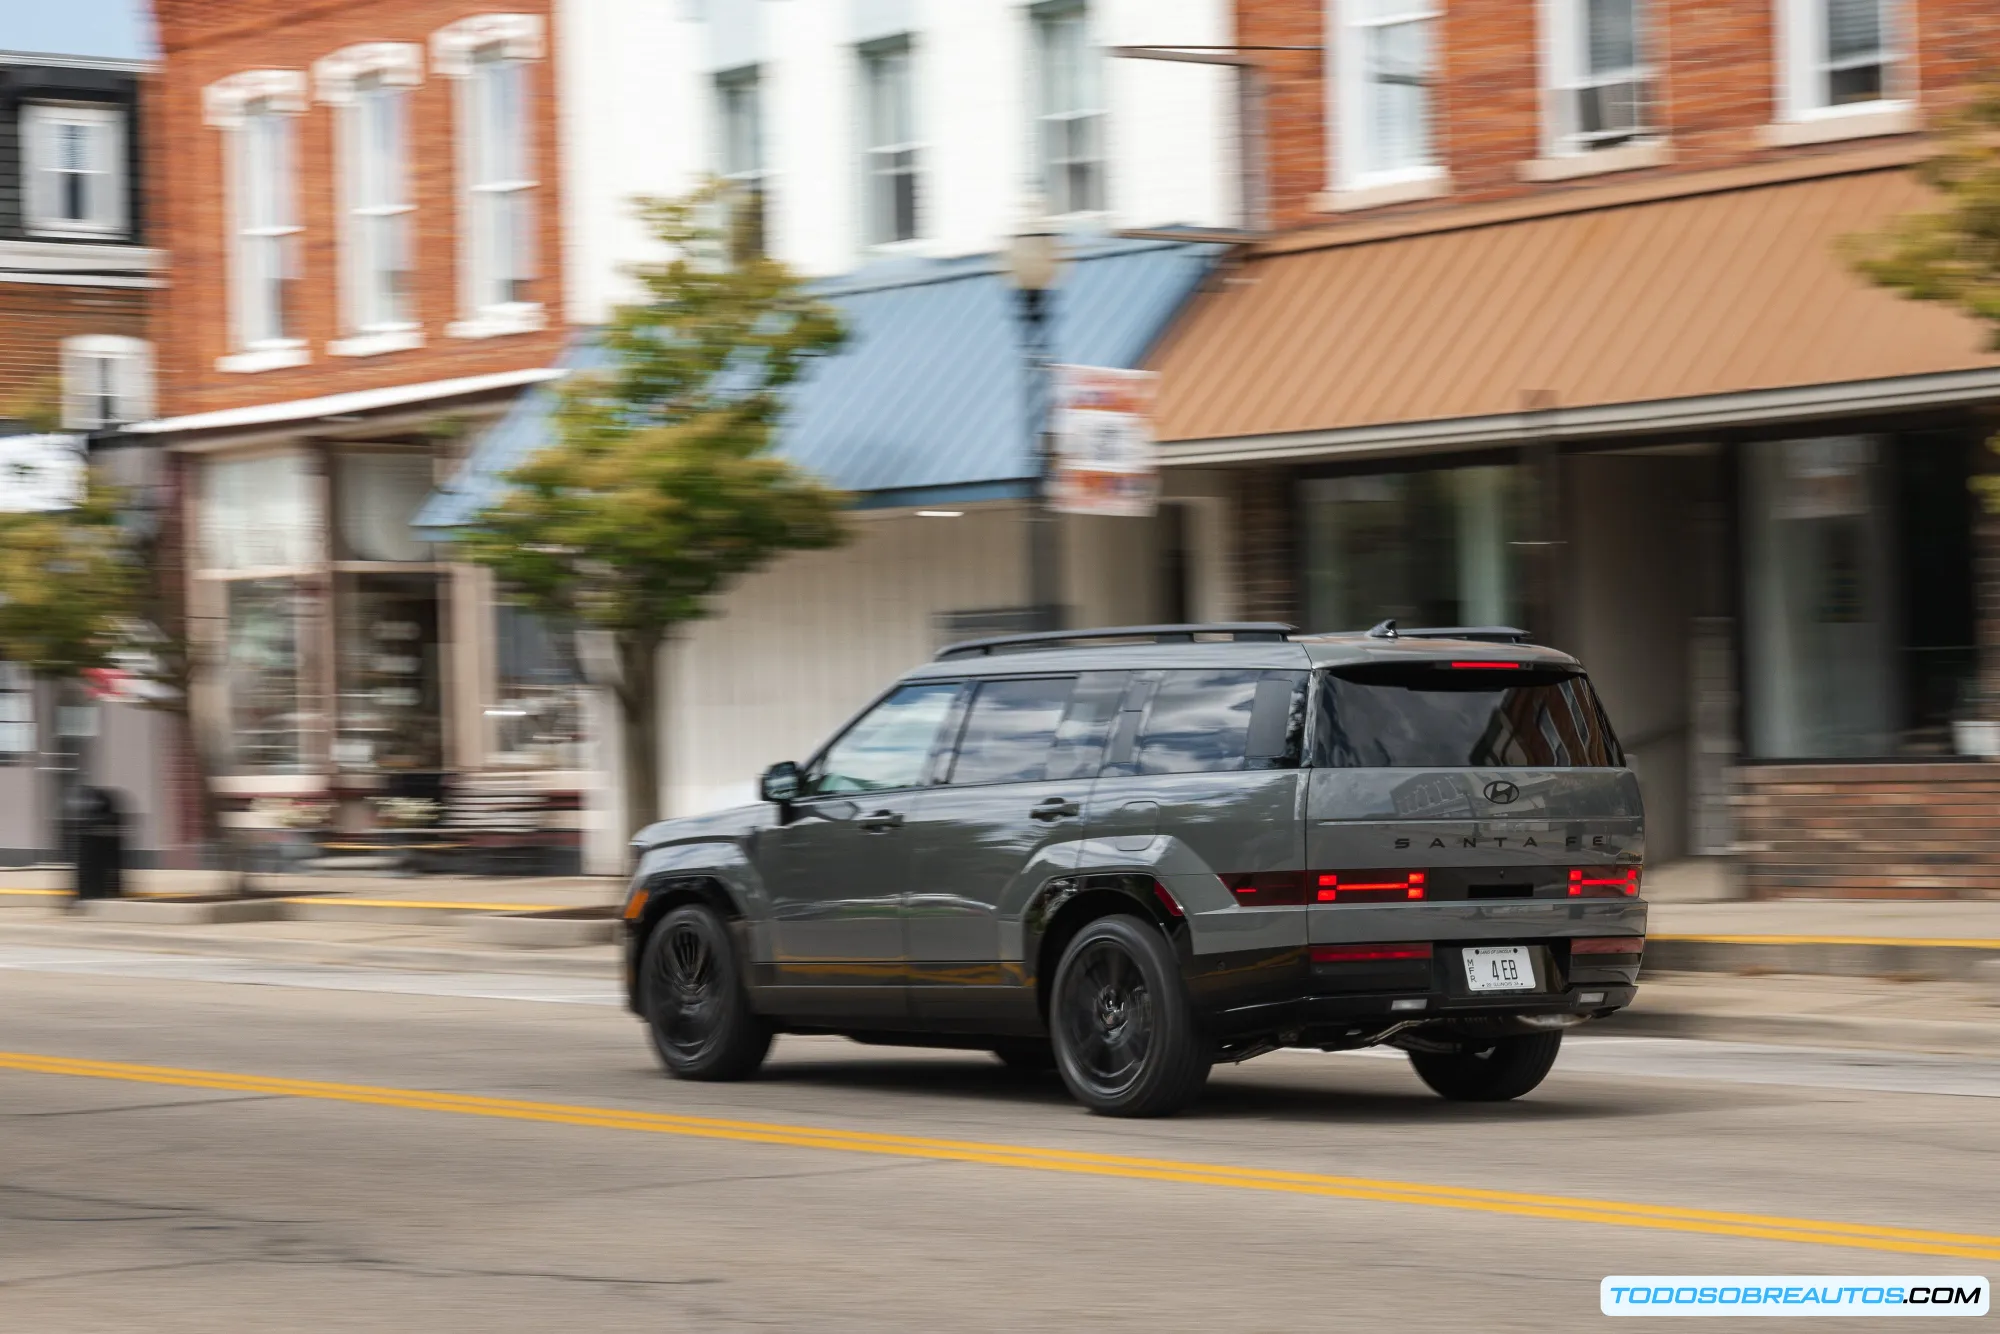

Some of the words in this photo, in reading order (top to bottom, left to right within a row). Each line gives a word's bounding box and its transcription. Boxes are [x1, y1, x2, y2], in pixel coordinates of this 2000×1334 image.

[1394, 836, 1538, 849] SANTA
[1565, 835, 1604, 847] FE
[1467, 959, 1477, 982] MFR
